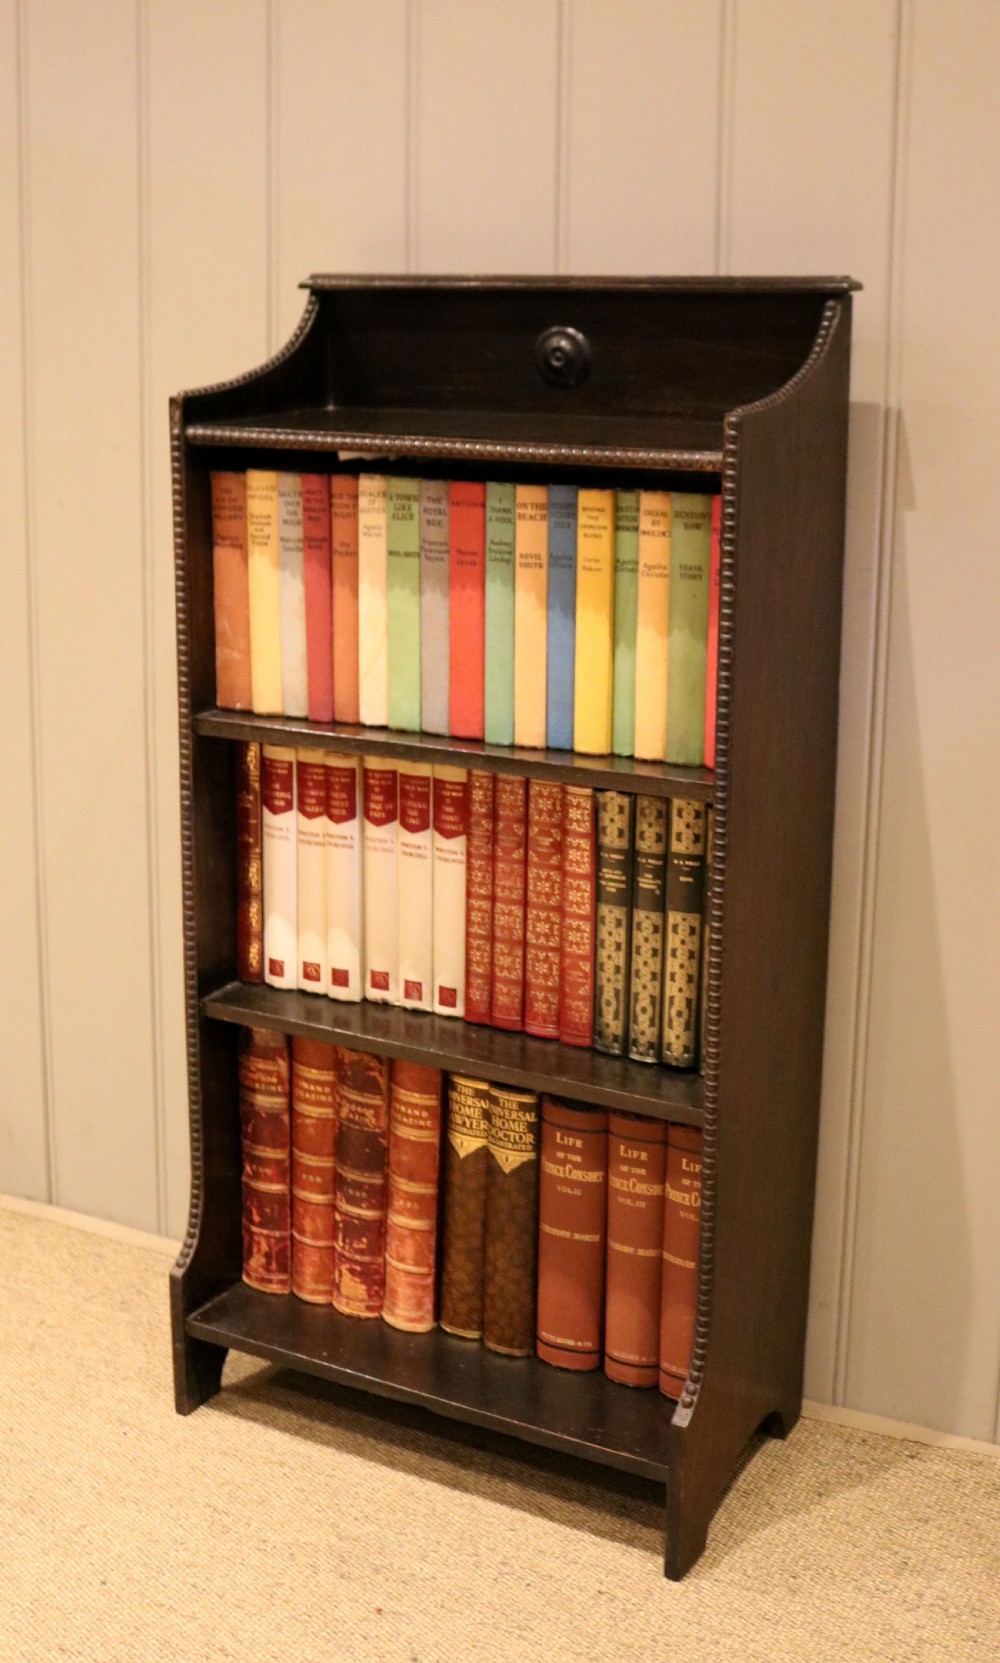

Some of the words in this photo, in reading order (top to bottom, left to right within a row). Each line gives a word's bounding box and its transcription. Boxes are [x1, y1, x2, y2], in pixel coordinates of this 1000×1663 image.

[395, 493, 419, 502] TOWN
[427, 496, 442, 504] THE
[394, 503, 412, 511] LIKE
[516, 502, 529, 510] ON
[529, 502, 548, 511] THE
[423, 507, 448, 516] ROYAL
[392, 512, 414, 521] ALICE
[517, 513, 547, 521] BEACH
[426, 519, 442, 527] BOX
[456, 1084, 475, 1097] THE
[499, 1098, 519, 1110] THE
[491, 1114, 528, 1132] HOME
[556, 1151, 566, 1159] OF
[567, 1153, 582, 1162] THE
[620, 1164, 630, 1172] OF
